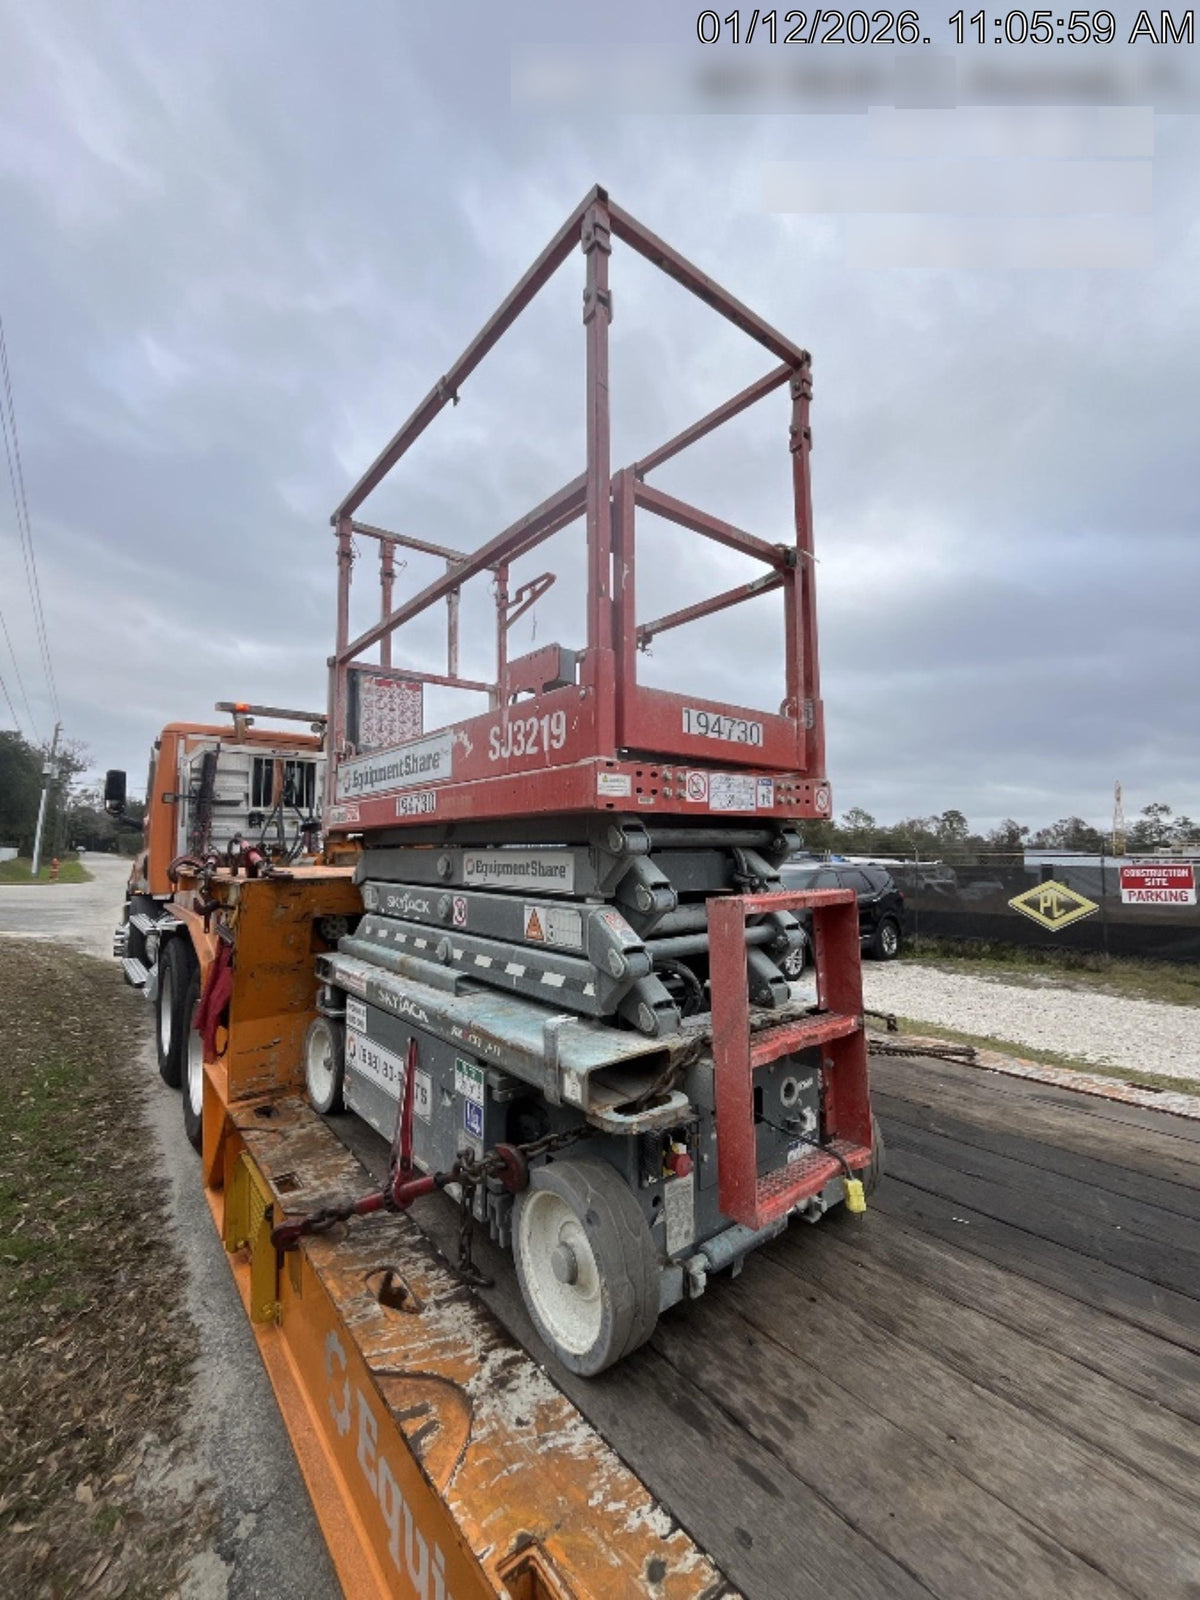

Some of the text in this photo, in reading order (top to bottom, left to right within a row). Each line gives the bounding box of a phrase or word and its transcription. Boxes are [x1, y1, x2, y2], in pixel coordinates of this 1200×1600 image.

[488, 710, 567, 762] SJ3219
[683, 709, 761, 747] 194730
[352, 752, 441, 790] EquipmentShare
[475, 859, 567, 880] EquipmentShare
[1123, 868, 1189, 878] CONSTRUCTION
[1144, 878, 1169, 886] SITE
[1127, 890, 1189, 902] PARKING
[357, 1388, 455, 1600] Equi
